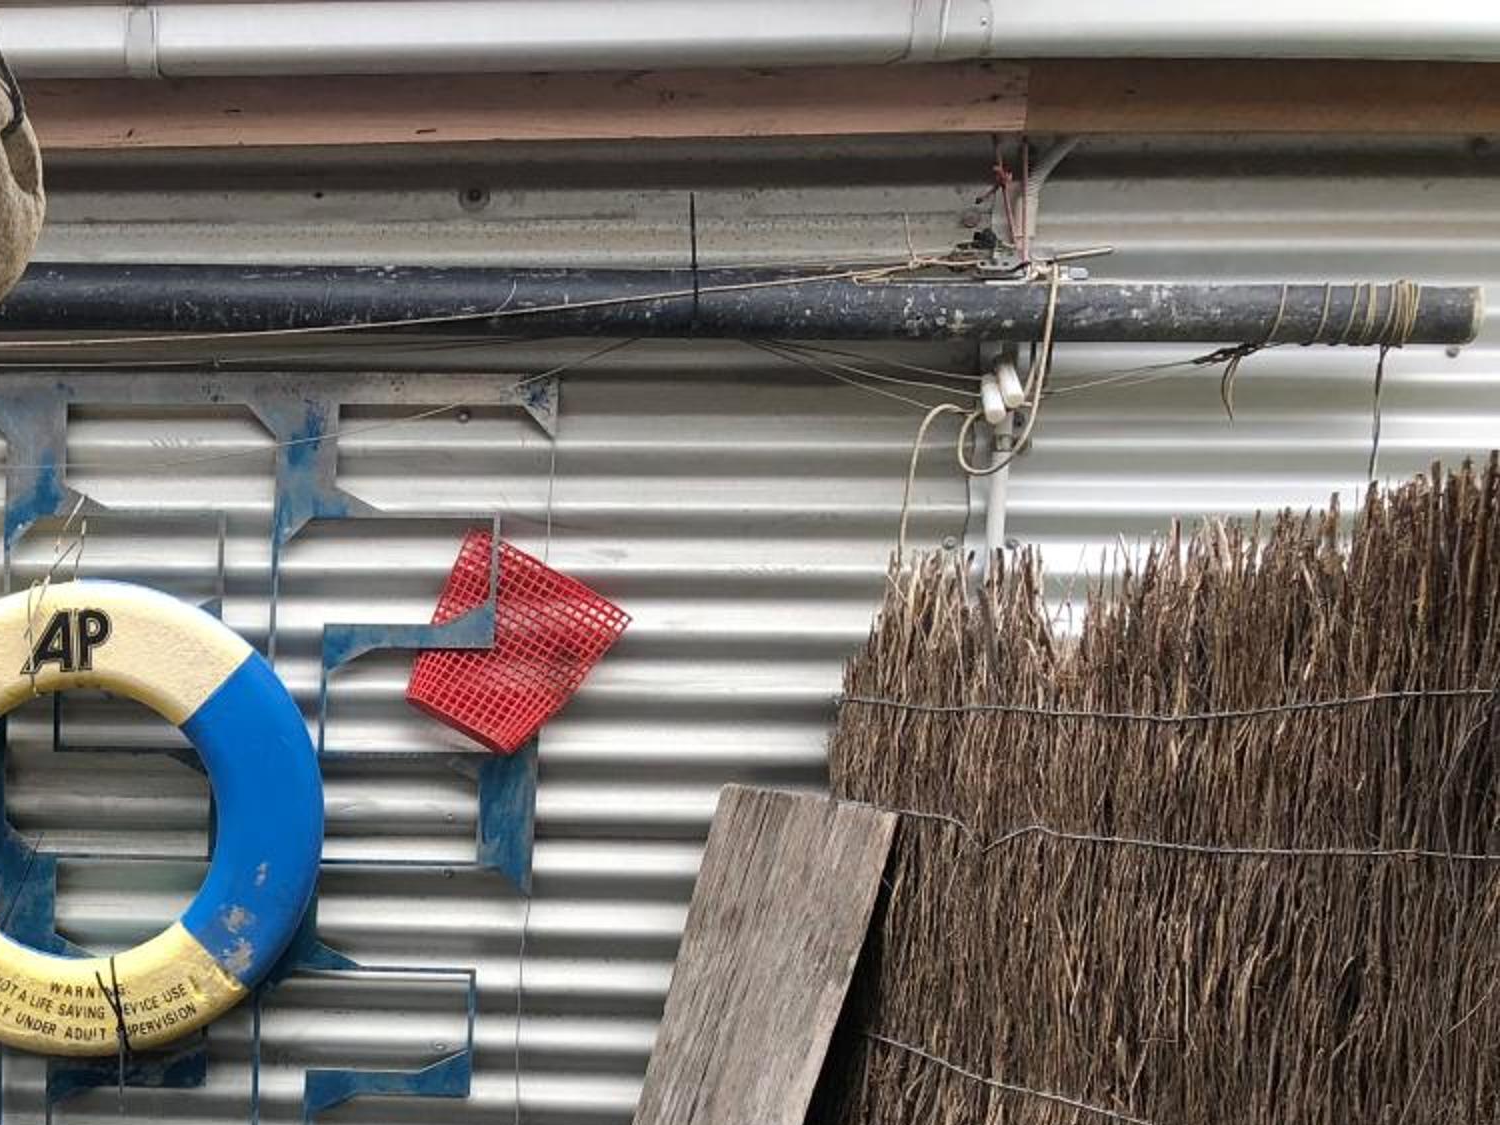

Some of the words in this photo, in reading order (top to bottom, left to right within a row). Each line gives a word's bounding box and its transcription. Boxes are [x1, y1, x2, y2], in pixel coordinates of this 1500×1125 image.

[20, 607, 113, 674] AP
[18, 989, 28, 1003] A
[29, 995, 54, 1013] LIFE
[58, 1003, 105, 1020] SAVING
[117, 995, 161, 1016] EVICE
[161, 983, 188, 1003] USE
[15, 1011, 57, 1036] UNDER
